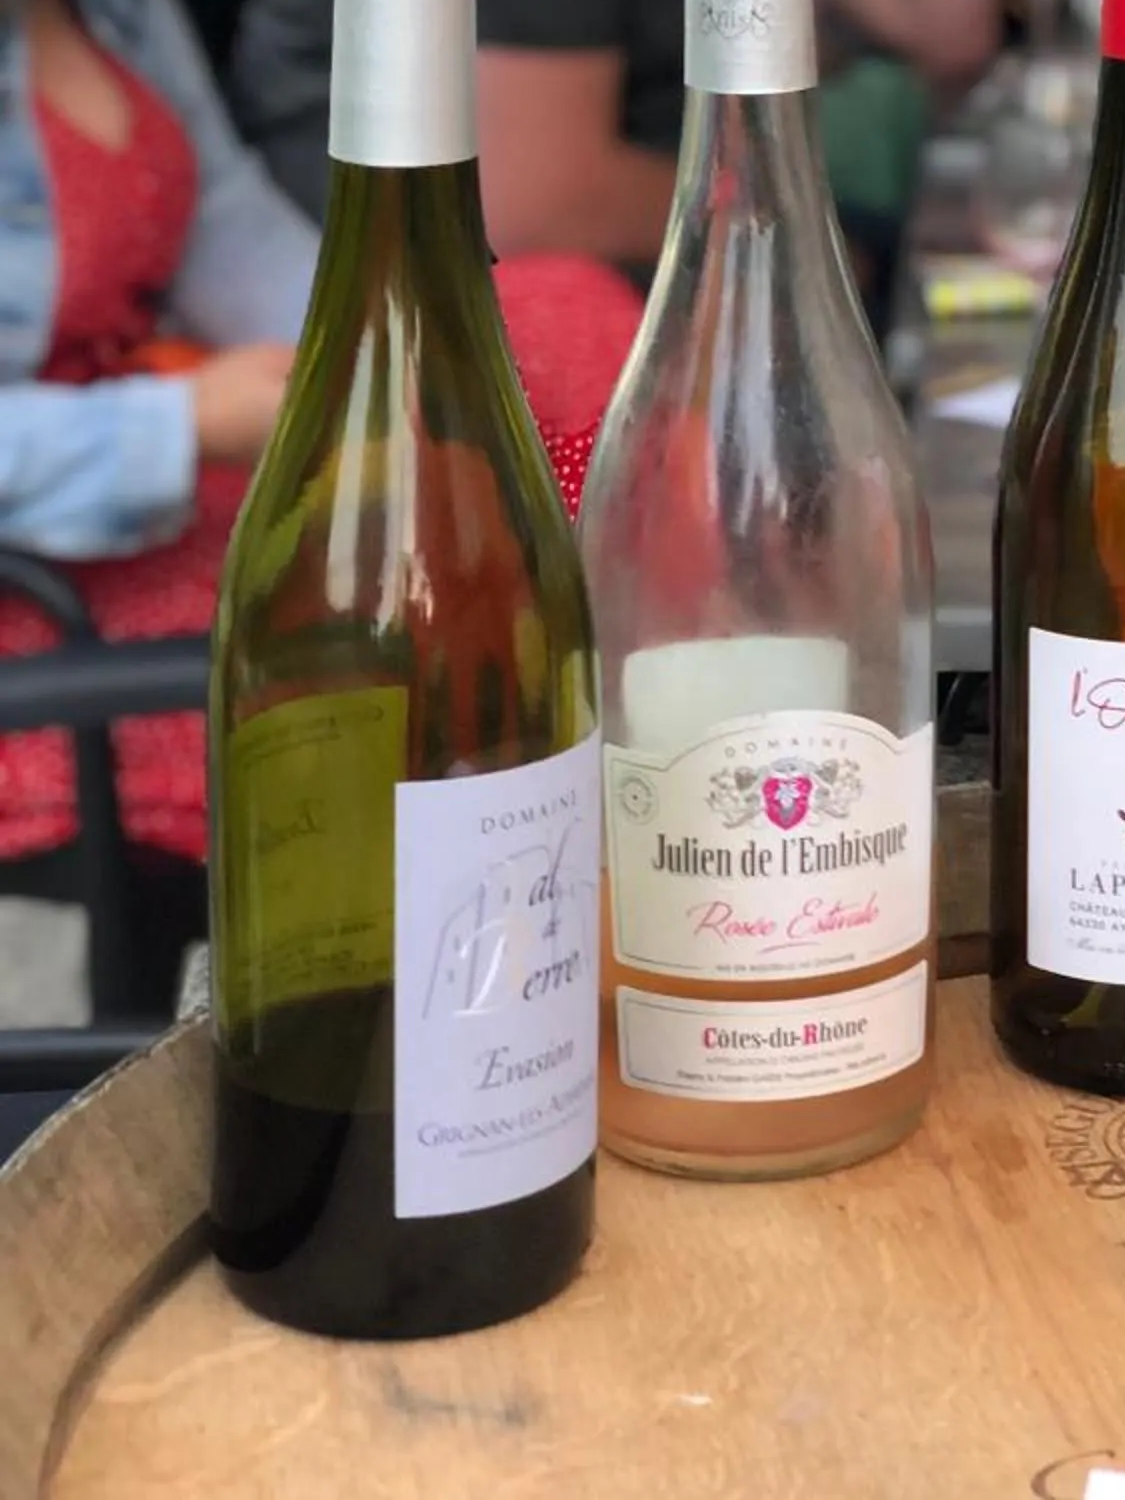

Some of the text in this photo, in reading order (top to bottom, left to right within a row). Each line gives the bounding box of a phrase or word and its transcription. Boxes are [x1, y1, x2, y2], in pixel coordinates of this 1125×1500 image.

[723, 735, 849, 759] DOMAINE
[652, 821, 908, 878] Julien de l'Embisque
[702, 1016, 868, 1050] Côtes-du-Rhône
